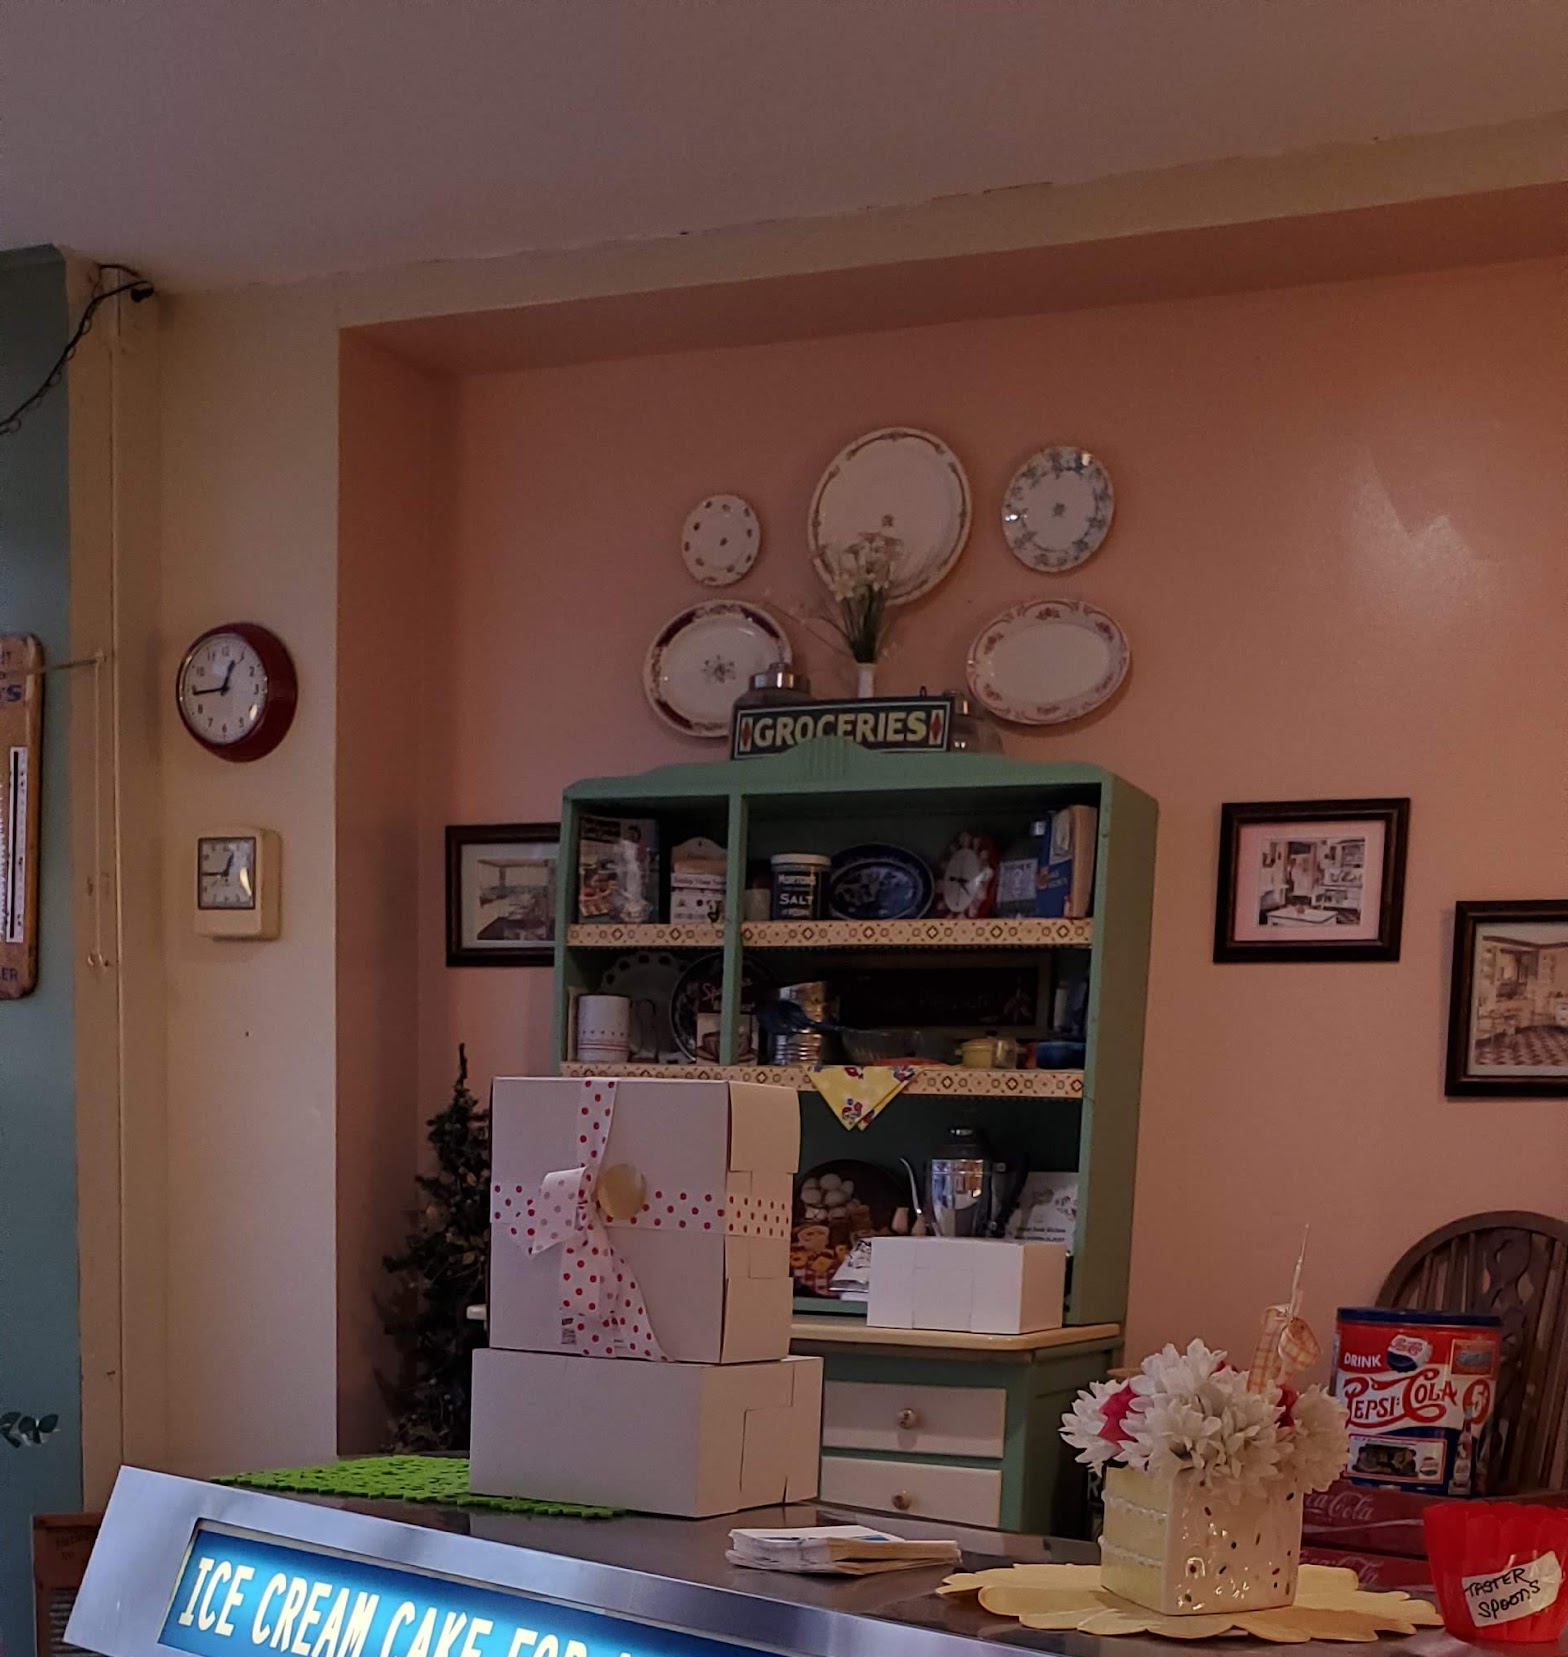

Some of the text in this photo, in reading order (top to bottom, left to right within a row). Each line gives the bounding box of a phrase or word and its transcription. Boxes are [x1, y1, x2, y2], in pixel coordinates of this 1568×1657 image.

[753, 710, 927, 748] GROCERIES
[779, 893, 813, 905] SALT
[1344, 1352, 1381, 1368] DRINK
[179, 1557, 255, 1637] ICE
[1464, 1567, 1533, 1598] TASTER
